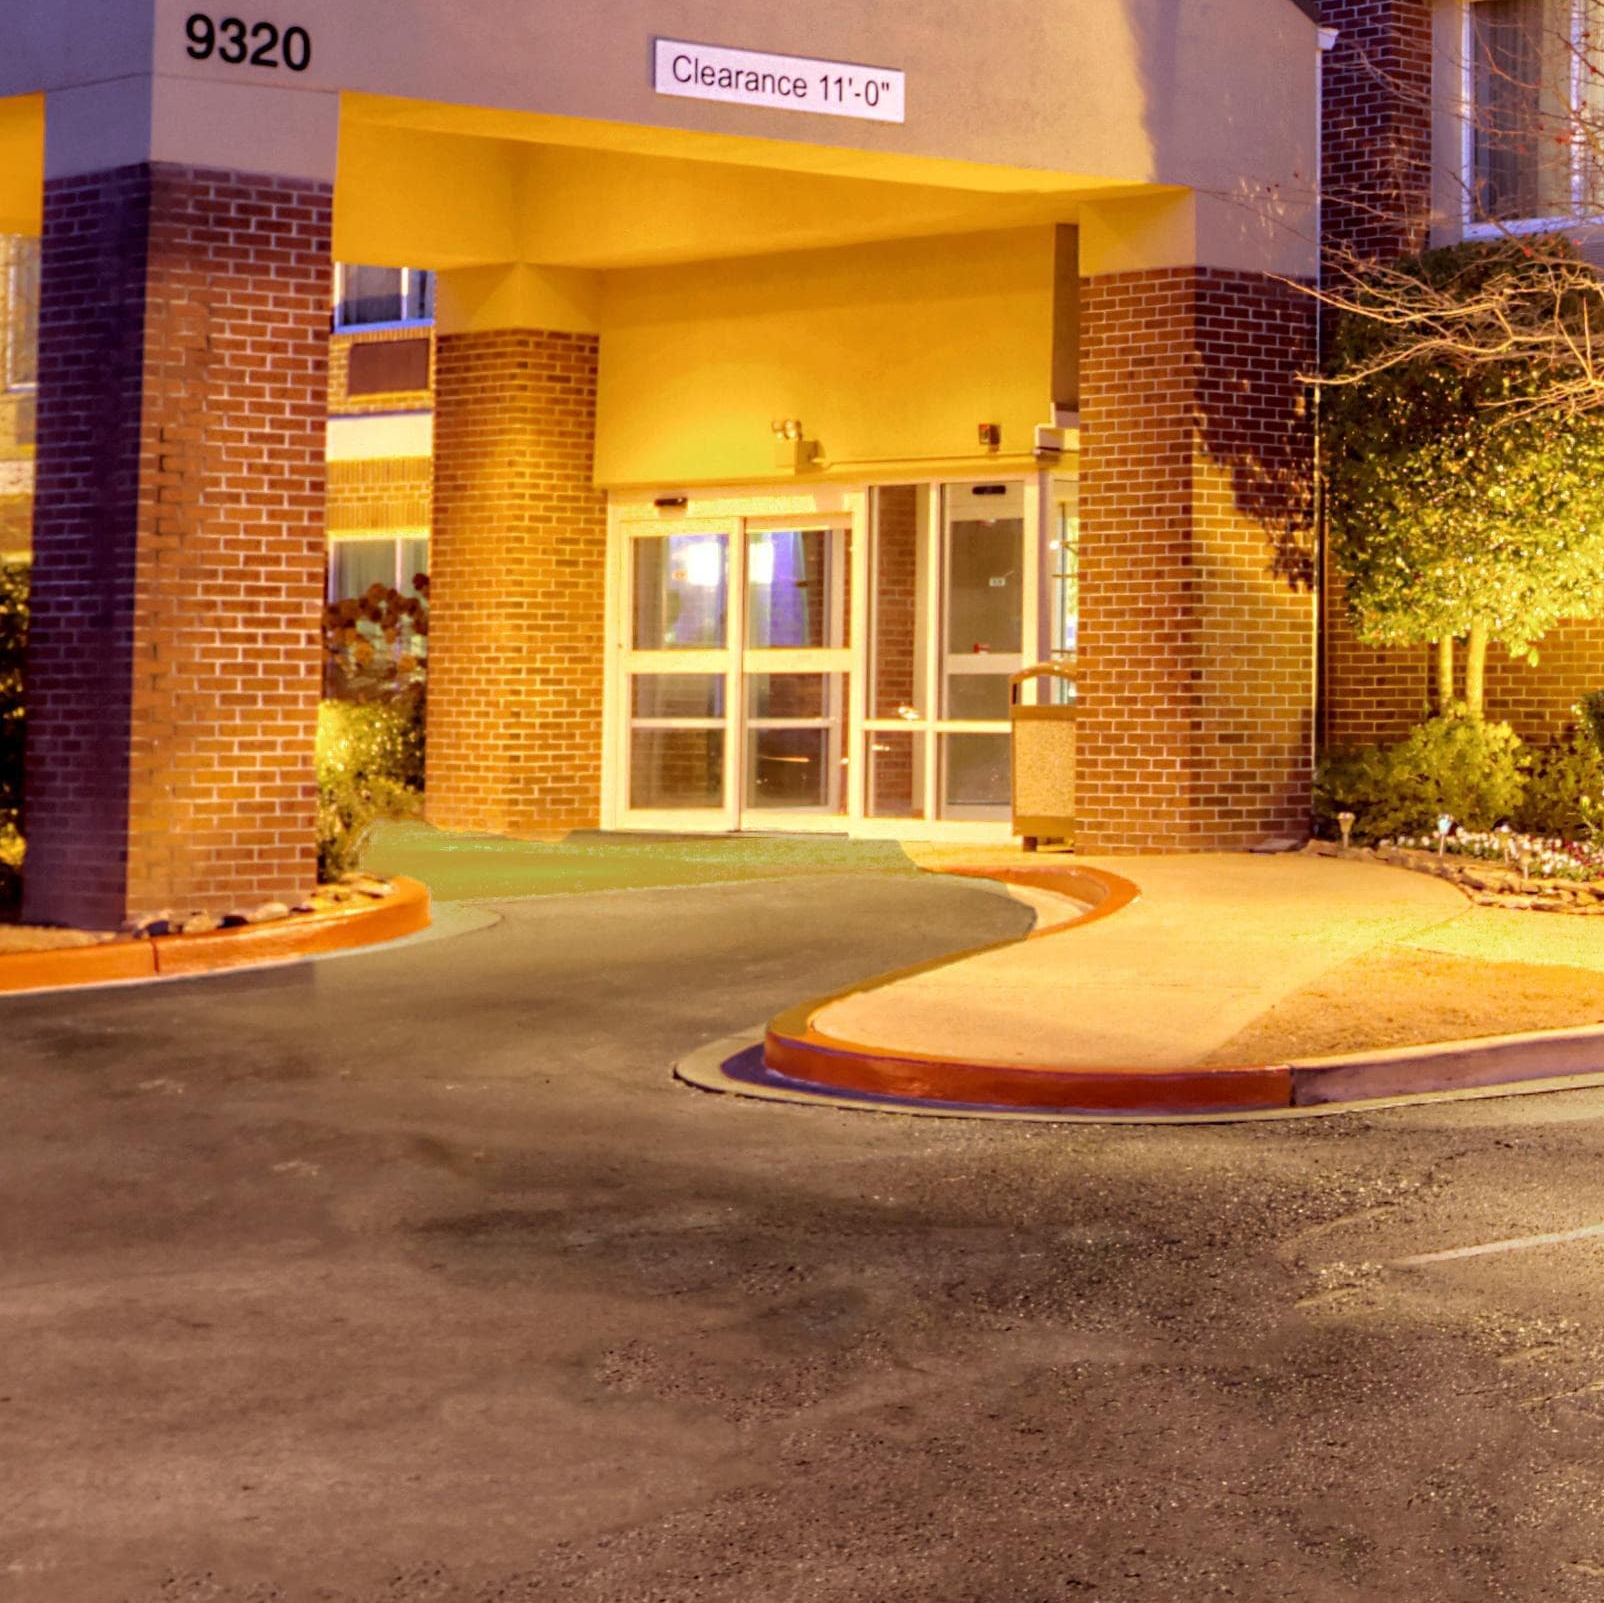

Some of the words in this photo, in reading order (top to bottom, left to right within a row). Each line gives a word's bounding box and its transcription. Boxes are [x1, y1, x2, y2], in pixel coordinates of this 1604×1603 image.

[186, 13, 311, 71] 9320
[672, 54, 807, 98] Clearance
[819, 74, 890, 107] 11'-0"
